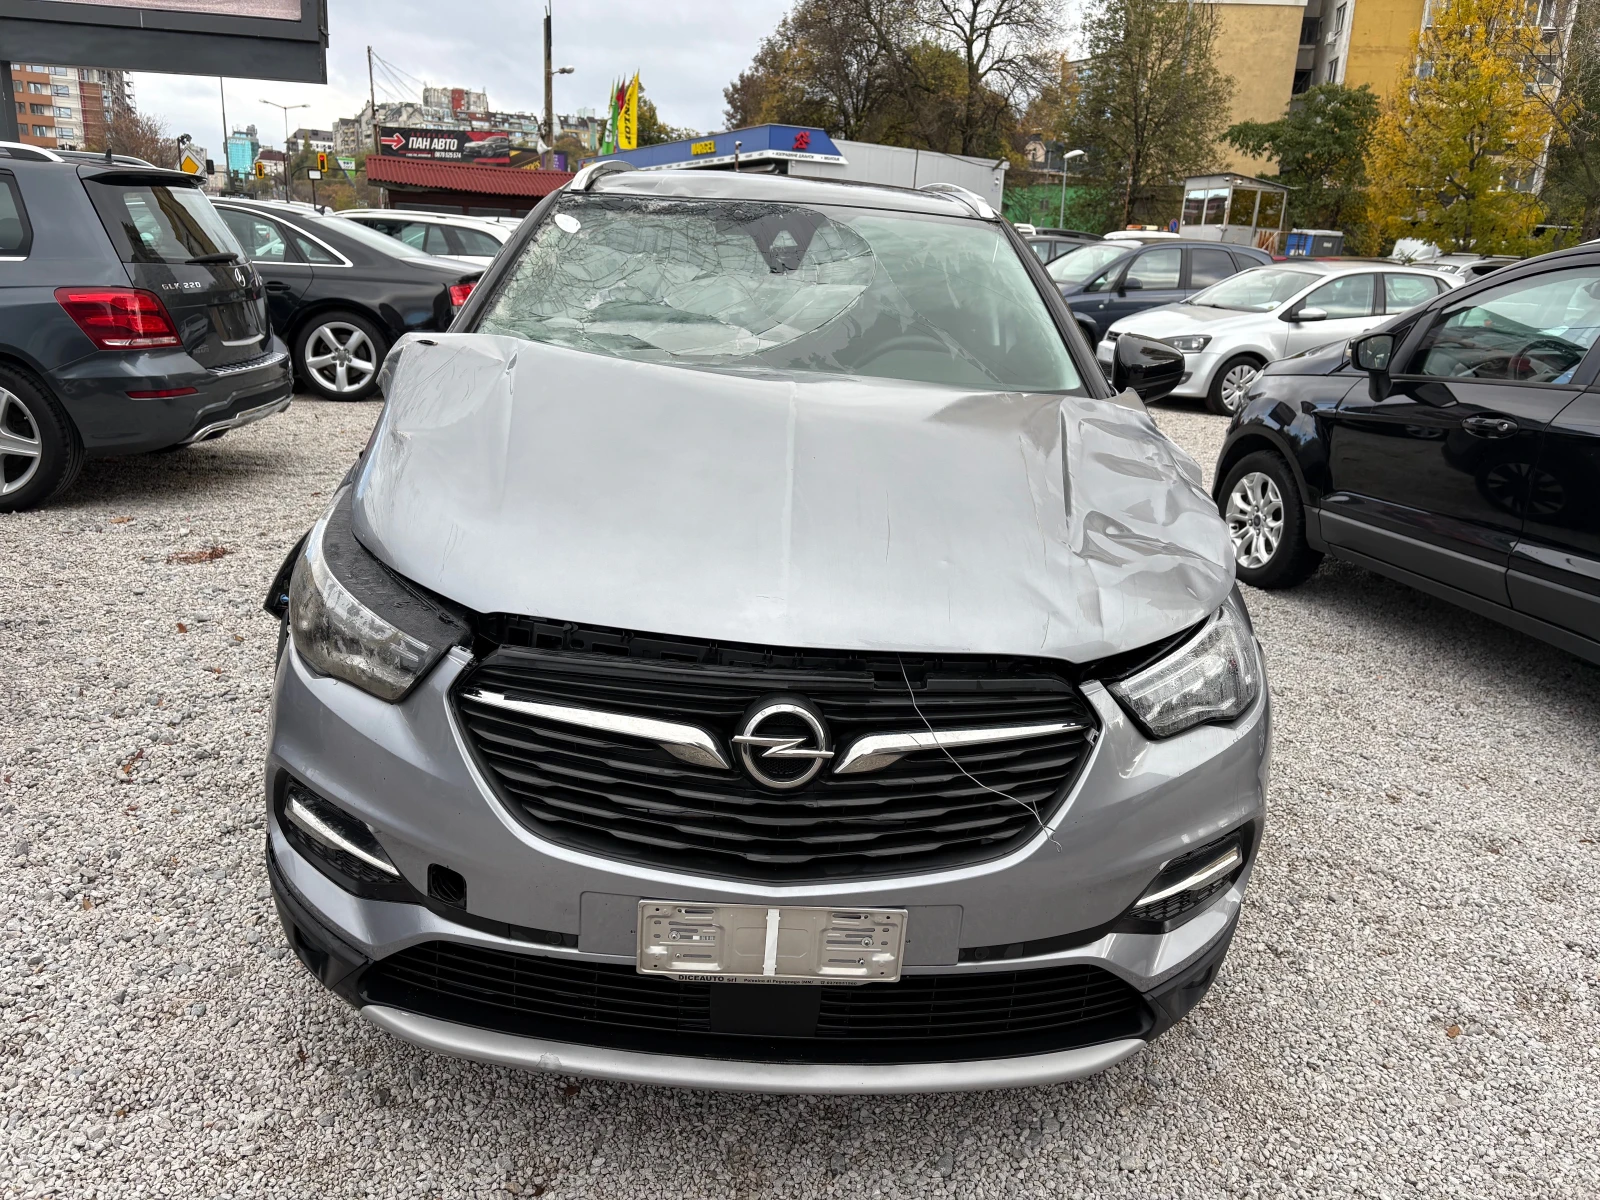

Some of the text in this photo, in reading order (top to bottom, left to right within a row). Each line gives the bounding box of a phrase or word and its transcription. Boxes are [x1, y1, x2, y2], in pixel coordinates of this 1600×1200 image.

[624, 94, 632, 145] UNLOP
[408, 137, 458, 150] ПАН АВТО
[183, 281, 201, 289] 220
[678, 974, 724, 982] DICEAUTO
